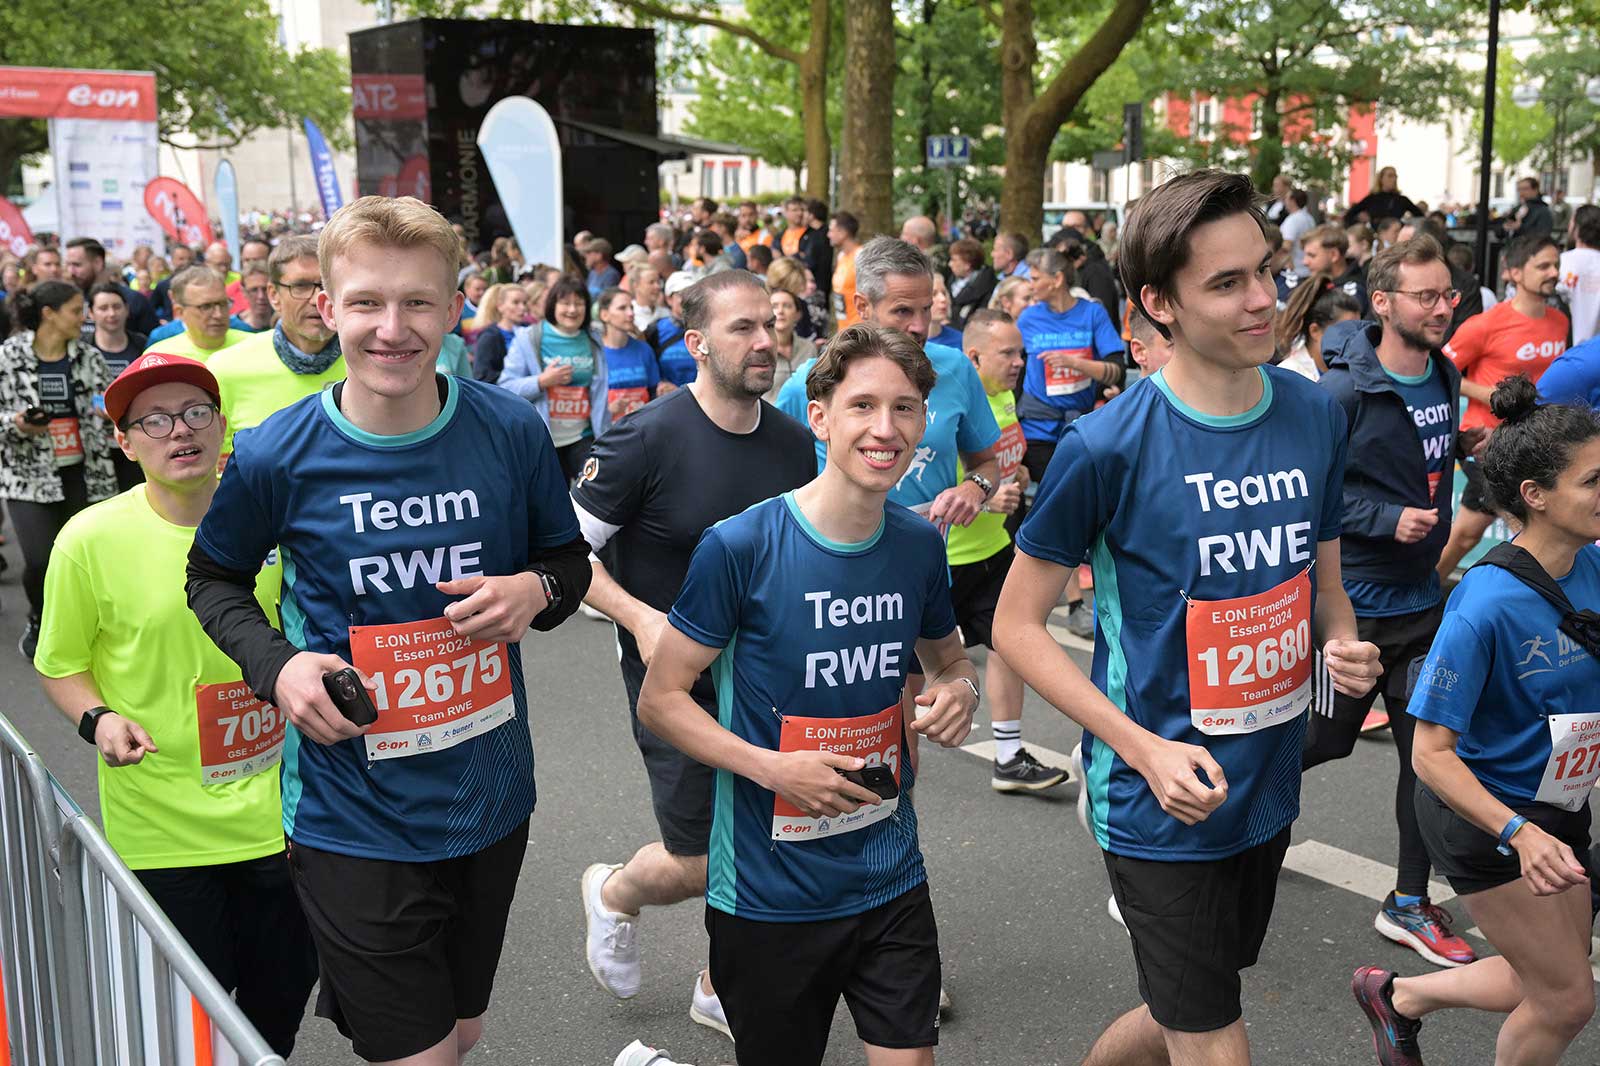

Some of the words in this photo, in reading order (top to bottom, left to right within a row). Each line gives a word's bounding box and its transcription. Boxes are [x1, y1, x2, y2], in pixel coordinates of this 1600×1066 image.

[1407, 402, 1453, 427] eam
[996, 443, 1023, 467] 7042
[1184, 468, 1309, 512] Team
[339, 488, 480, 533] Team
[1198, 521, 1311, 577] RWE
[349, 541, 483, 596] RWE
[804, 591, 903, 629] Team
[1212, 608, 1247, 624] E.ON
[1250, 586, 1300, 619] Firmenlauf
[1229, 623, 1267, 638] Essen
[1269, 607, 1292, 630] 2024
[374, 633, 410, 649] E.ON
[413, 628, 458, 644] Firme
[393, 648, 434, 662] Essen
[436, 635, 472, 655] 2024
[804, 641, 903, 688] RWE
[1197, 618, 1309, 687] 12680
[371, 643, 503, 711] 12675
[1241, 691, 1271, 702] Team
[1272, 677, 1293, 694] RWE
[217, 687, 245, 700] E.ON
[412, 711, 445, 724] Team
[447, 700, 473, 717] RWE
[452, 721, 474, 735] bunert
[805, 727, 838, 739] E.ON
[839, 716, 894, 738] Firmenlauf
[1571, 721, 1594, 733] E.ON
[228, 748, 248, 759] GSE
[819, 742, 853, 752] Essen
[855, 734, 882, 750] 2024
[1554, 743, 1600, 781] 127
